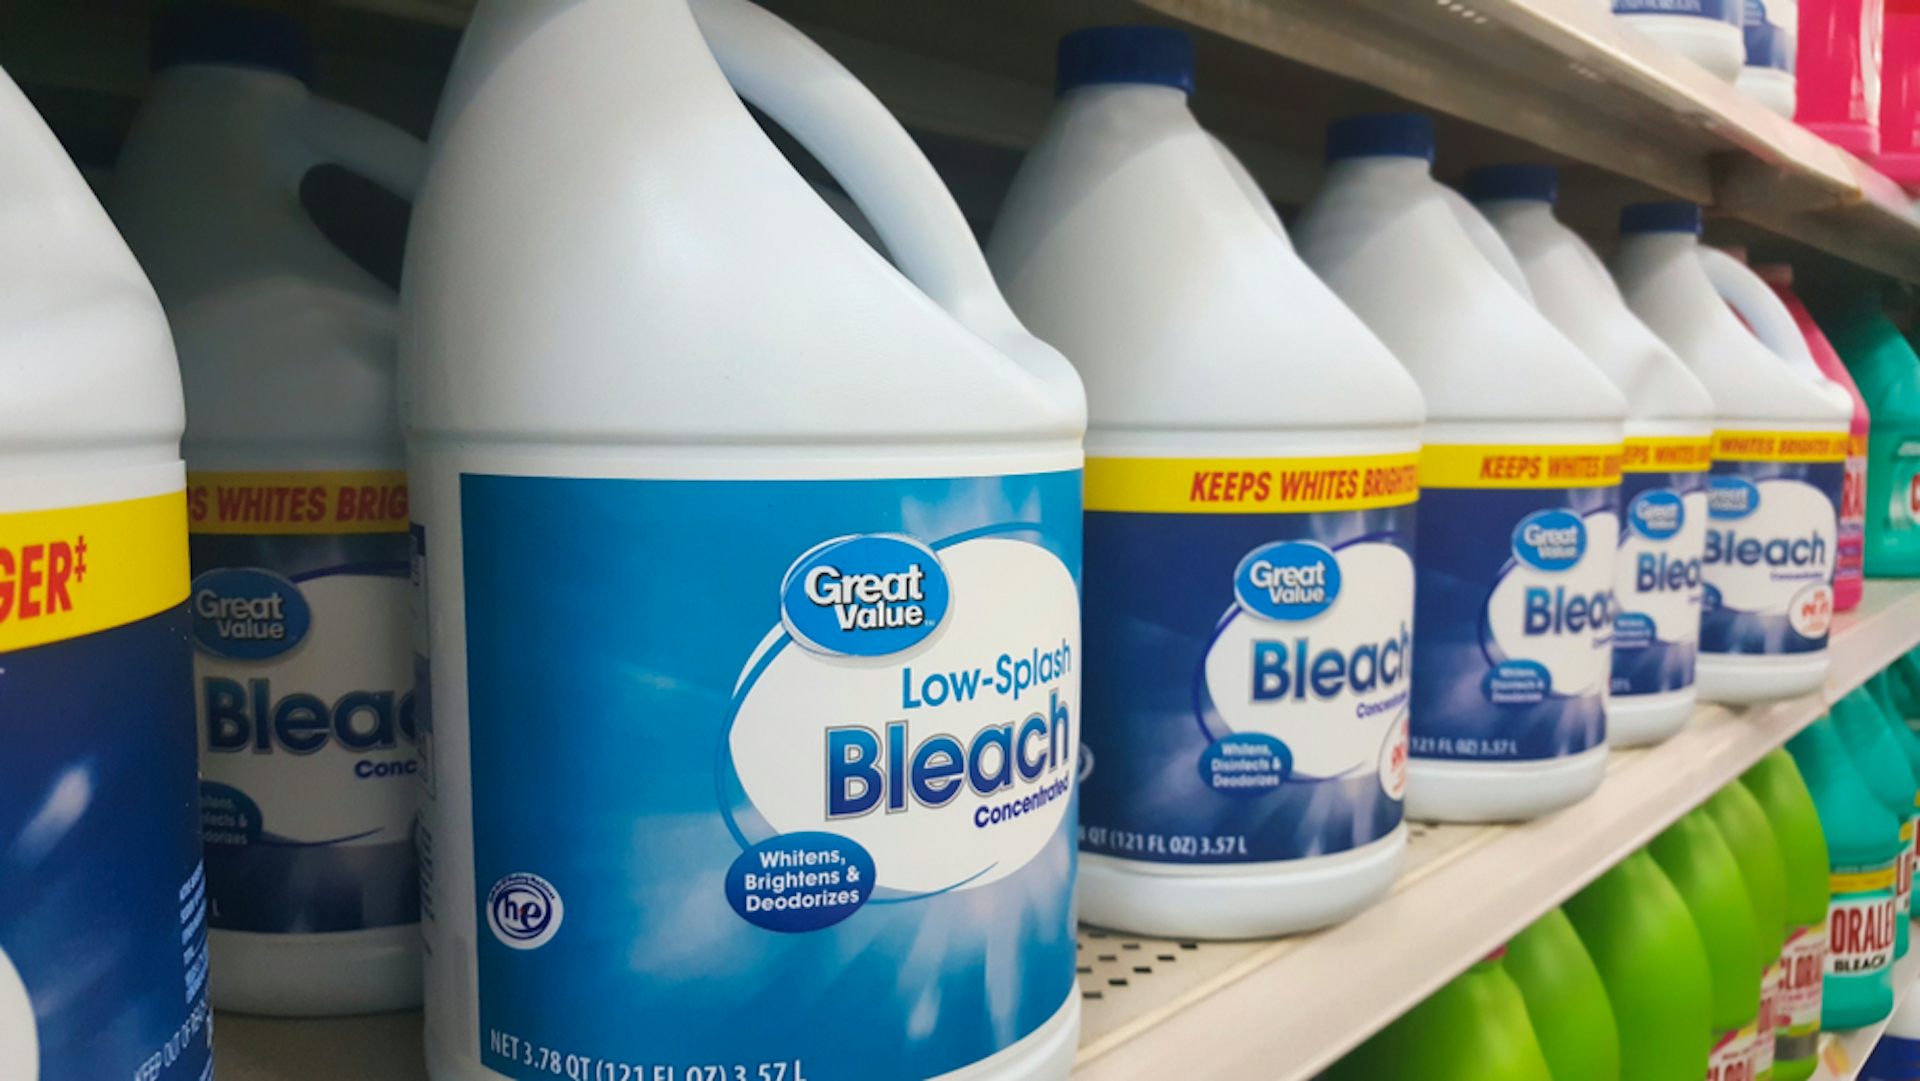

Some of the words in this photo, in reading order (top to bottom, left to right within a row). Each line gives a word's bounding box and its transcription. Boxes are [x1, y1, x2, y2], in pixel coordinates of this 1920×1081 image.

[1480, 456, 1542, 480] KEEPS
[1190, 471, 1272, 502] KEEPS
[1281, 470, 1359, 501] WHITES
[217, 486, 327, 523] WHITES
[1524, 523, 1579, 549] Great
[1703, 527, 1826, 567] Bleach
[804, 563, 924, 606] Great
[1250, 560, 1326, 588] Great
[198, 588, 284, 621] Great
[1269, 585, 1325, 605] Value
[834, 602, 924, 631] Value
[1522, 585, 1614, 637] Blea
[217, 618, 285, 641] Value
[902, 637, 1072, 709] Low-Splash
[354, 759, 417, 780] Conc
[824, 687, 1071, 822] Bleach
[973, 769, 1070, 829] Concentrated
[1088, 826, 1107, 846] QT
[1110, 829, 1144, 850] (121
[1147, 833, 1166, 854] FL
[1169, 834, 1198, 857] OZ)
[1201, 835, 1236, 856] 3.57
[1239, 835, 1249, 855] L
[759, 847, 846, 870] Whitens,
[745, 869, 841, 894] Brightens
[846, 865, 860, 884] &
[745, 887, 860, 913] Deodorizes
[490, 1028, 520, 1061] NET
[523, 1042, 562, 1075] 3.78
[565, 1055, 591, 1081] QT
[596, 1059, 643, 1081] (121
[733, 1061, 788, 1081] 3.57
[794, 1059, 807, 1081] L
